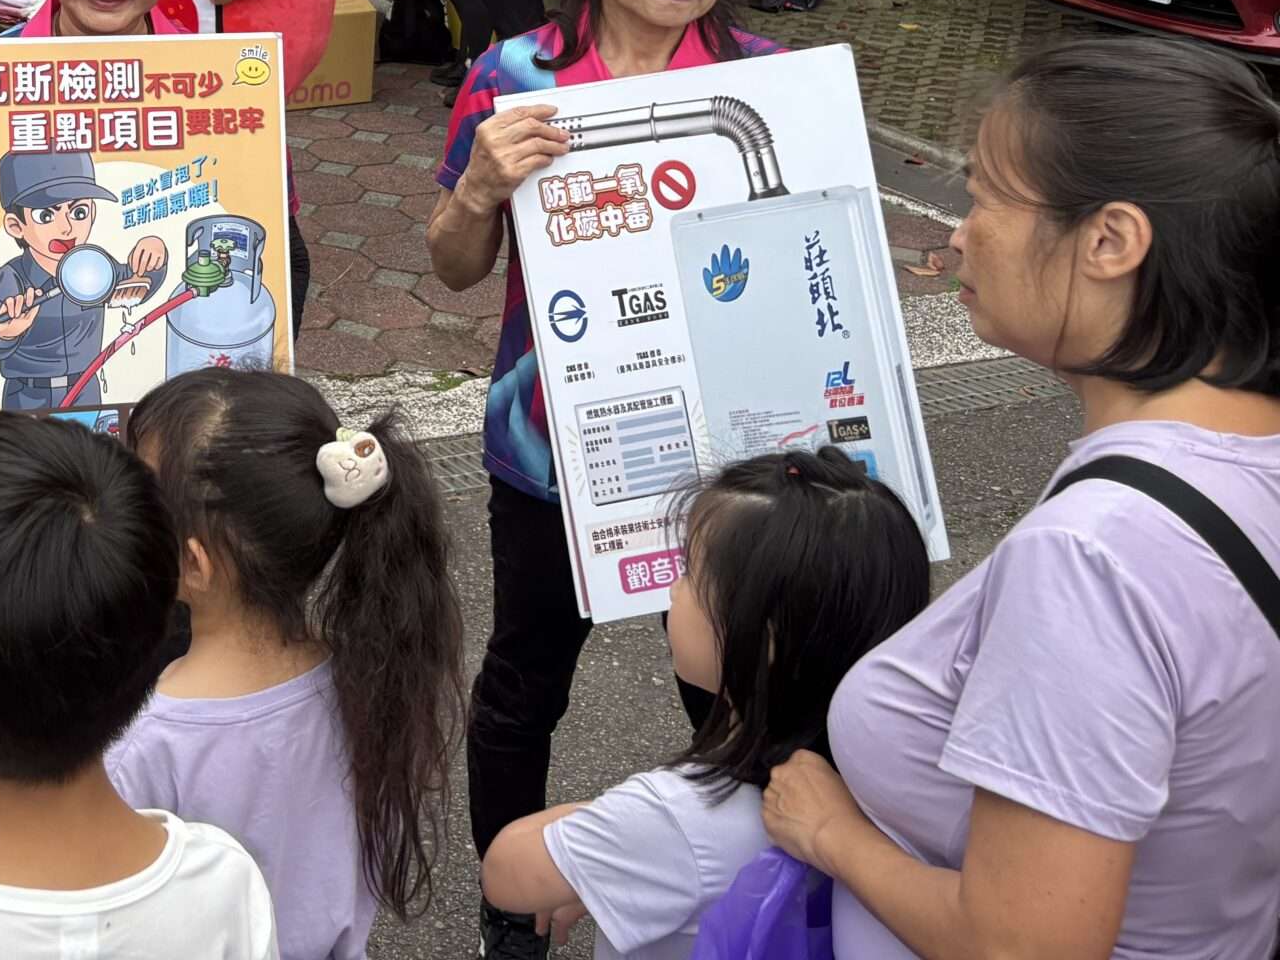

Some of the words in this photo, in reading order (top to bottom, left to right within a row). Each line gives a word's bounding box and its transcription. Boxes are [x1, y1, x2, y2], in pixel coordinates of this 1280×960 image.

[241, 46, 268, 60] smile
[540, 164, 647, 211] 防範一氧
[547, 199, 652, 245] 化碳中毒
[611, 288, 667, 317] TGAS
[825, 361, 856, 389] 12L
